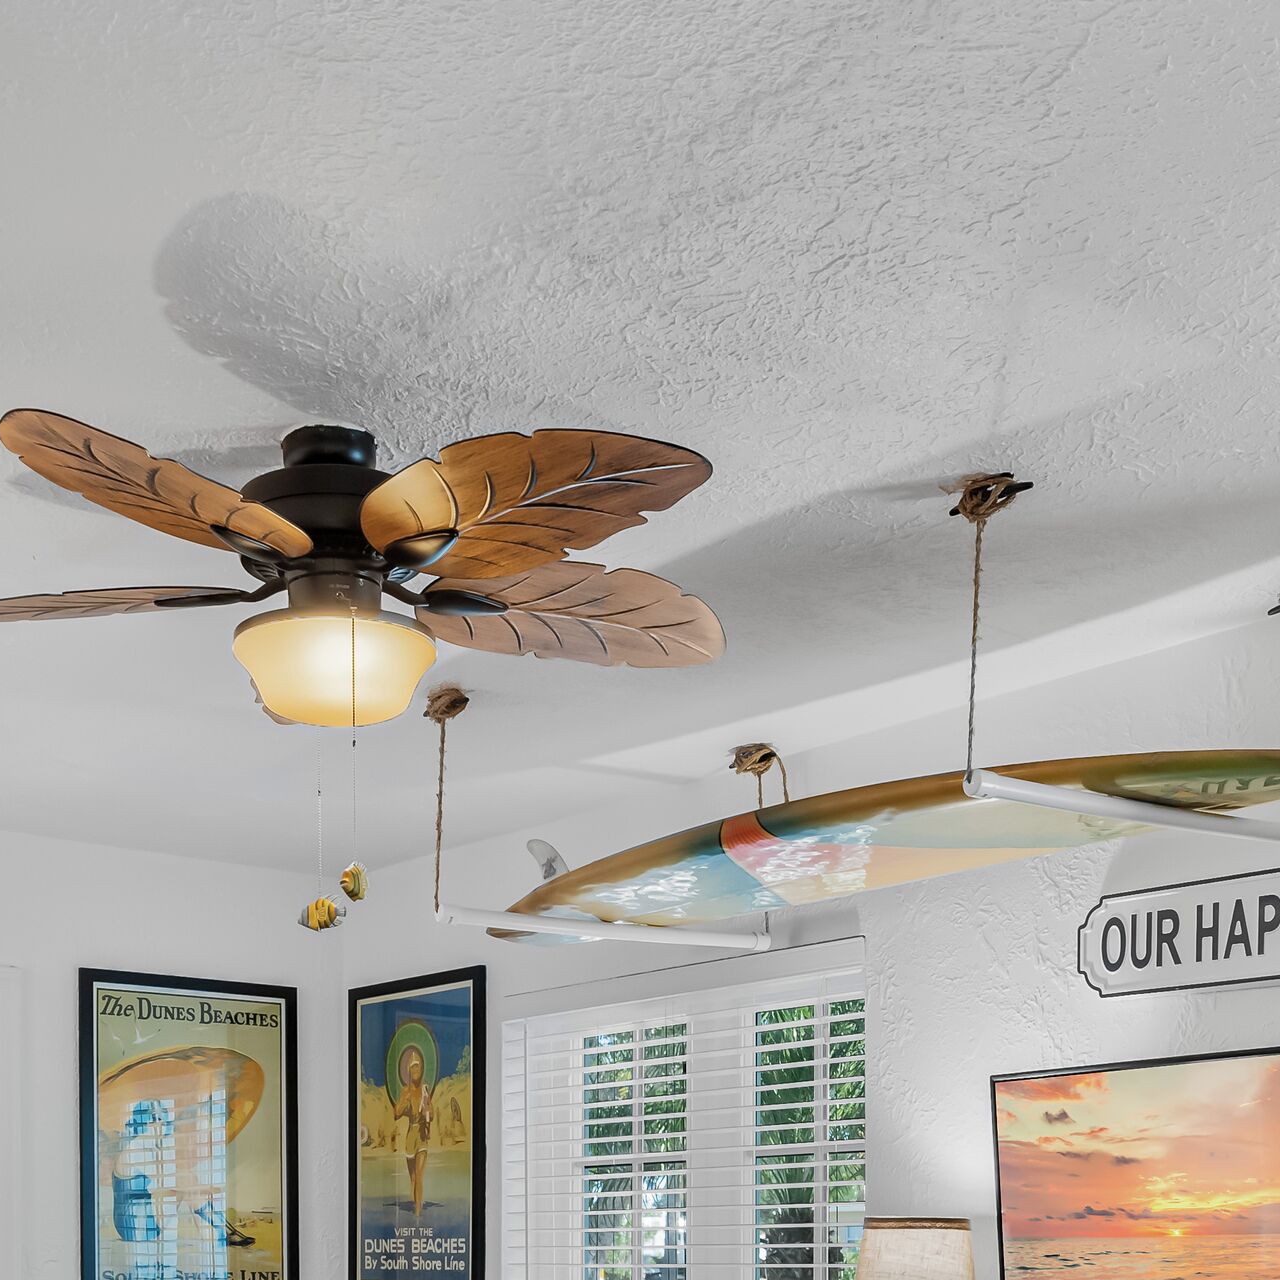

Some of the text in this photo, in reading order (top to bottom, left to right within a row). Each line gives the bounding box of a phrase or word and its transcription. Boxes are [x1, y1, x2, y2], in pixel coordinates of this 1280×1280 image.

[1101, 908, 1182, 974] OUR
[99, 994, 279, 1028] The DUNES BEACHES
[394, 1227, 433, 1237] VISIT THE
[364, 1238, 466, 1254] DUNES BEACHES
[364, 1256, 466, 1271] By South Shore Line
